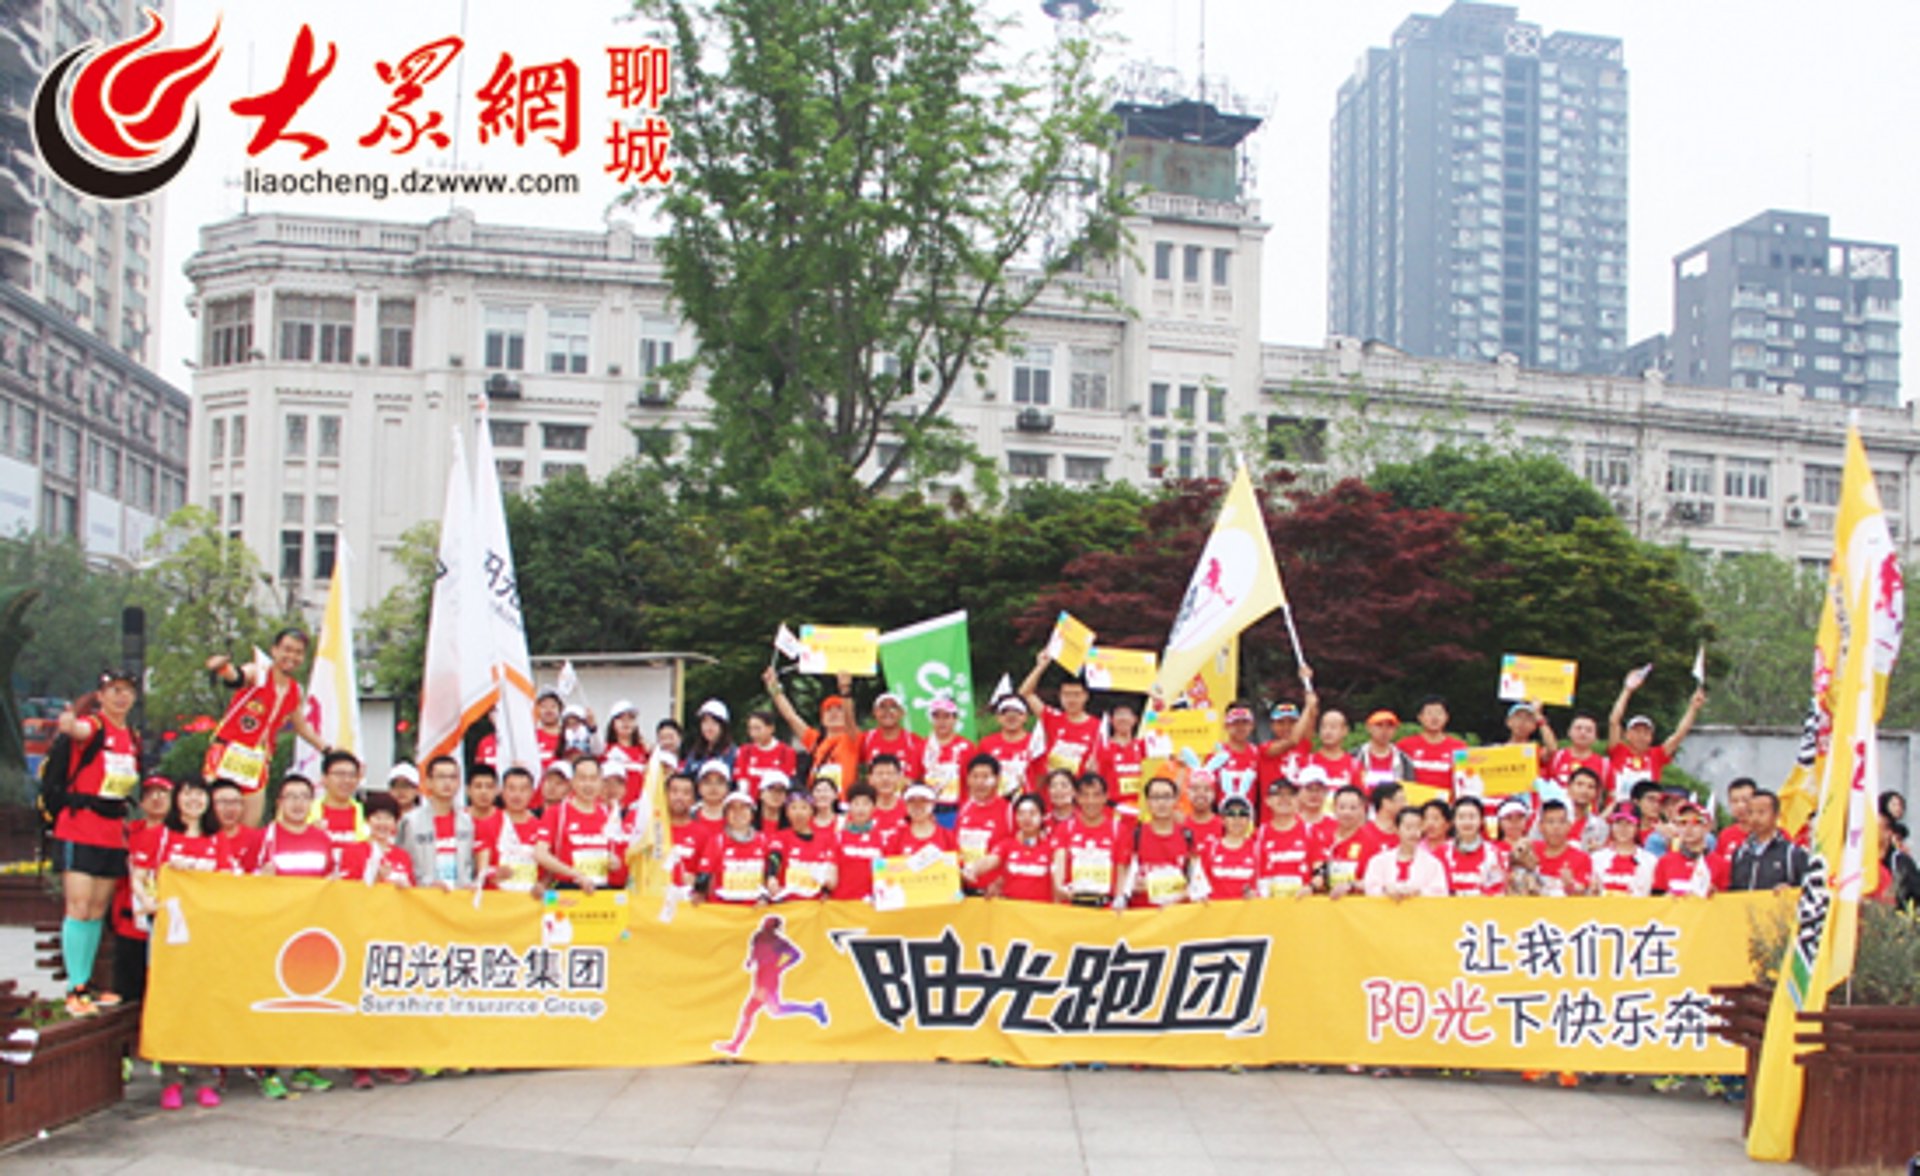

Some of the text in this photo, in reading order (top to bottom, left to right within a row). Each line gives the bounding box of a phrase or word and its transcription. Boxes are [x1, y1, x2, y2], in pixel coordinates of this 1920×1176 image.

[364, 944, 604, 990] 阳光保险集团
[1459, 923, 1677, 975] 让我们在
[850, 930, 1268, 1033] 阳光跑团
[1367, 980, 1735, 1046] 阳光下快乐奔
